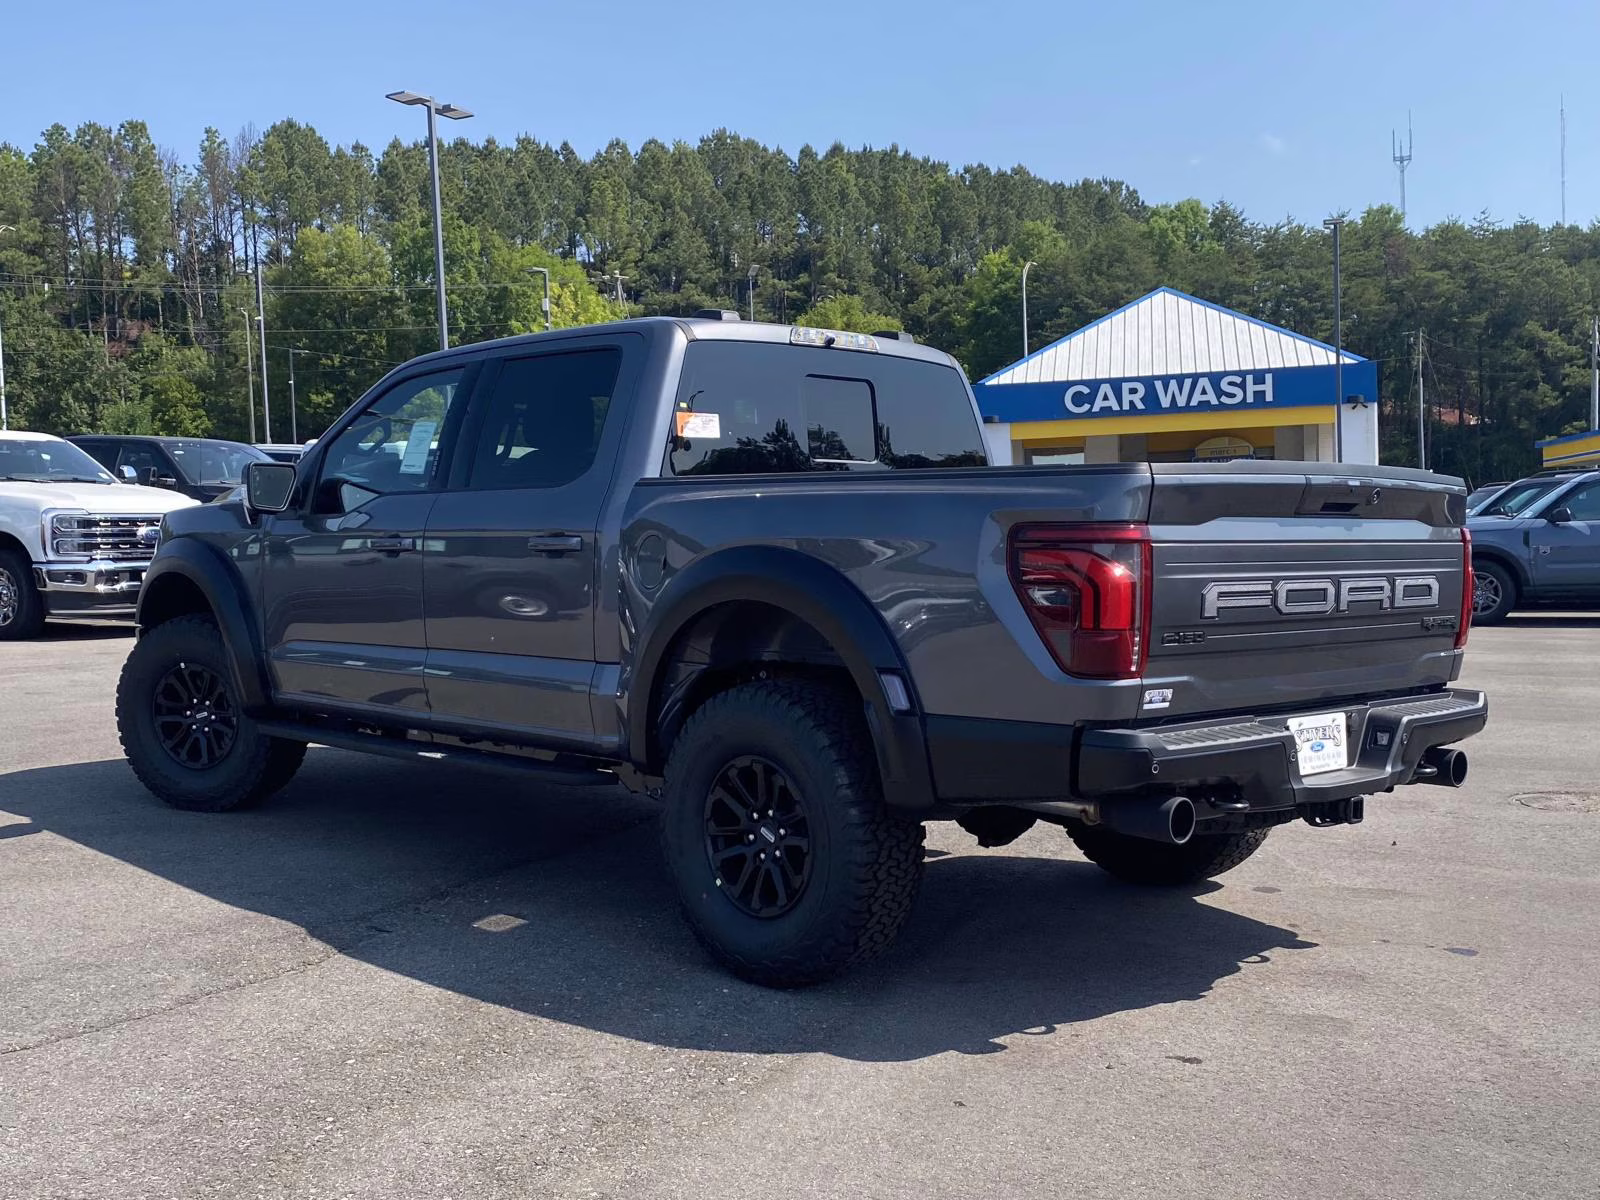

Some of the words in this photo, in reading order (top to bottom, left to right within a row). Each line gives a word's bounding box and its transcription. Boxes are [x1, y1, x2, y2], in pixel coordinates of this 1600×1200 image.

[1064, 381, 1146, 413] CAR
[1154, 373, 1274, 408] WASH
[1200, 574, 1440, 620] FORD
